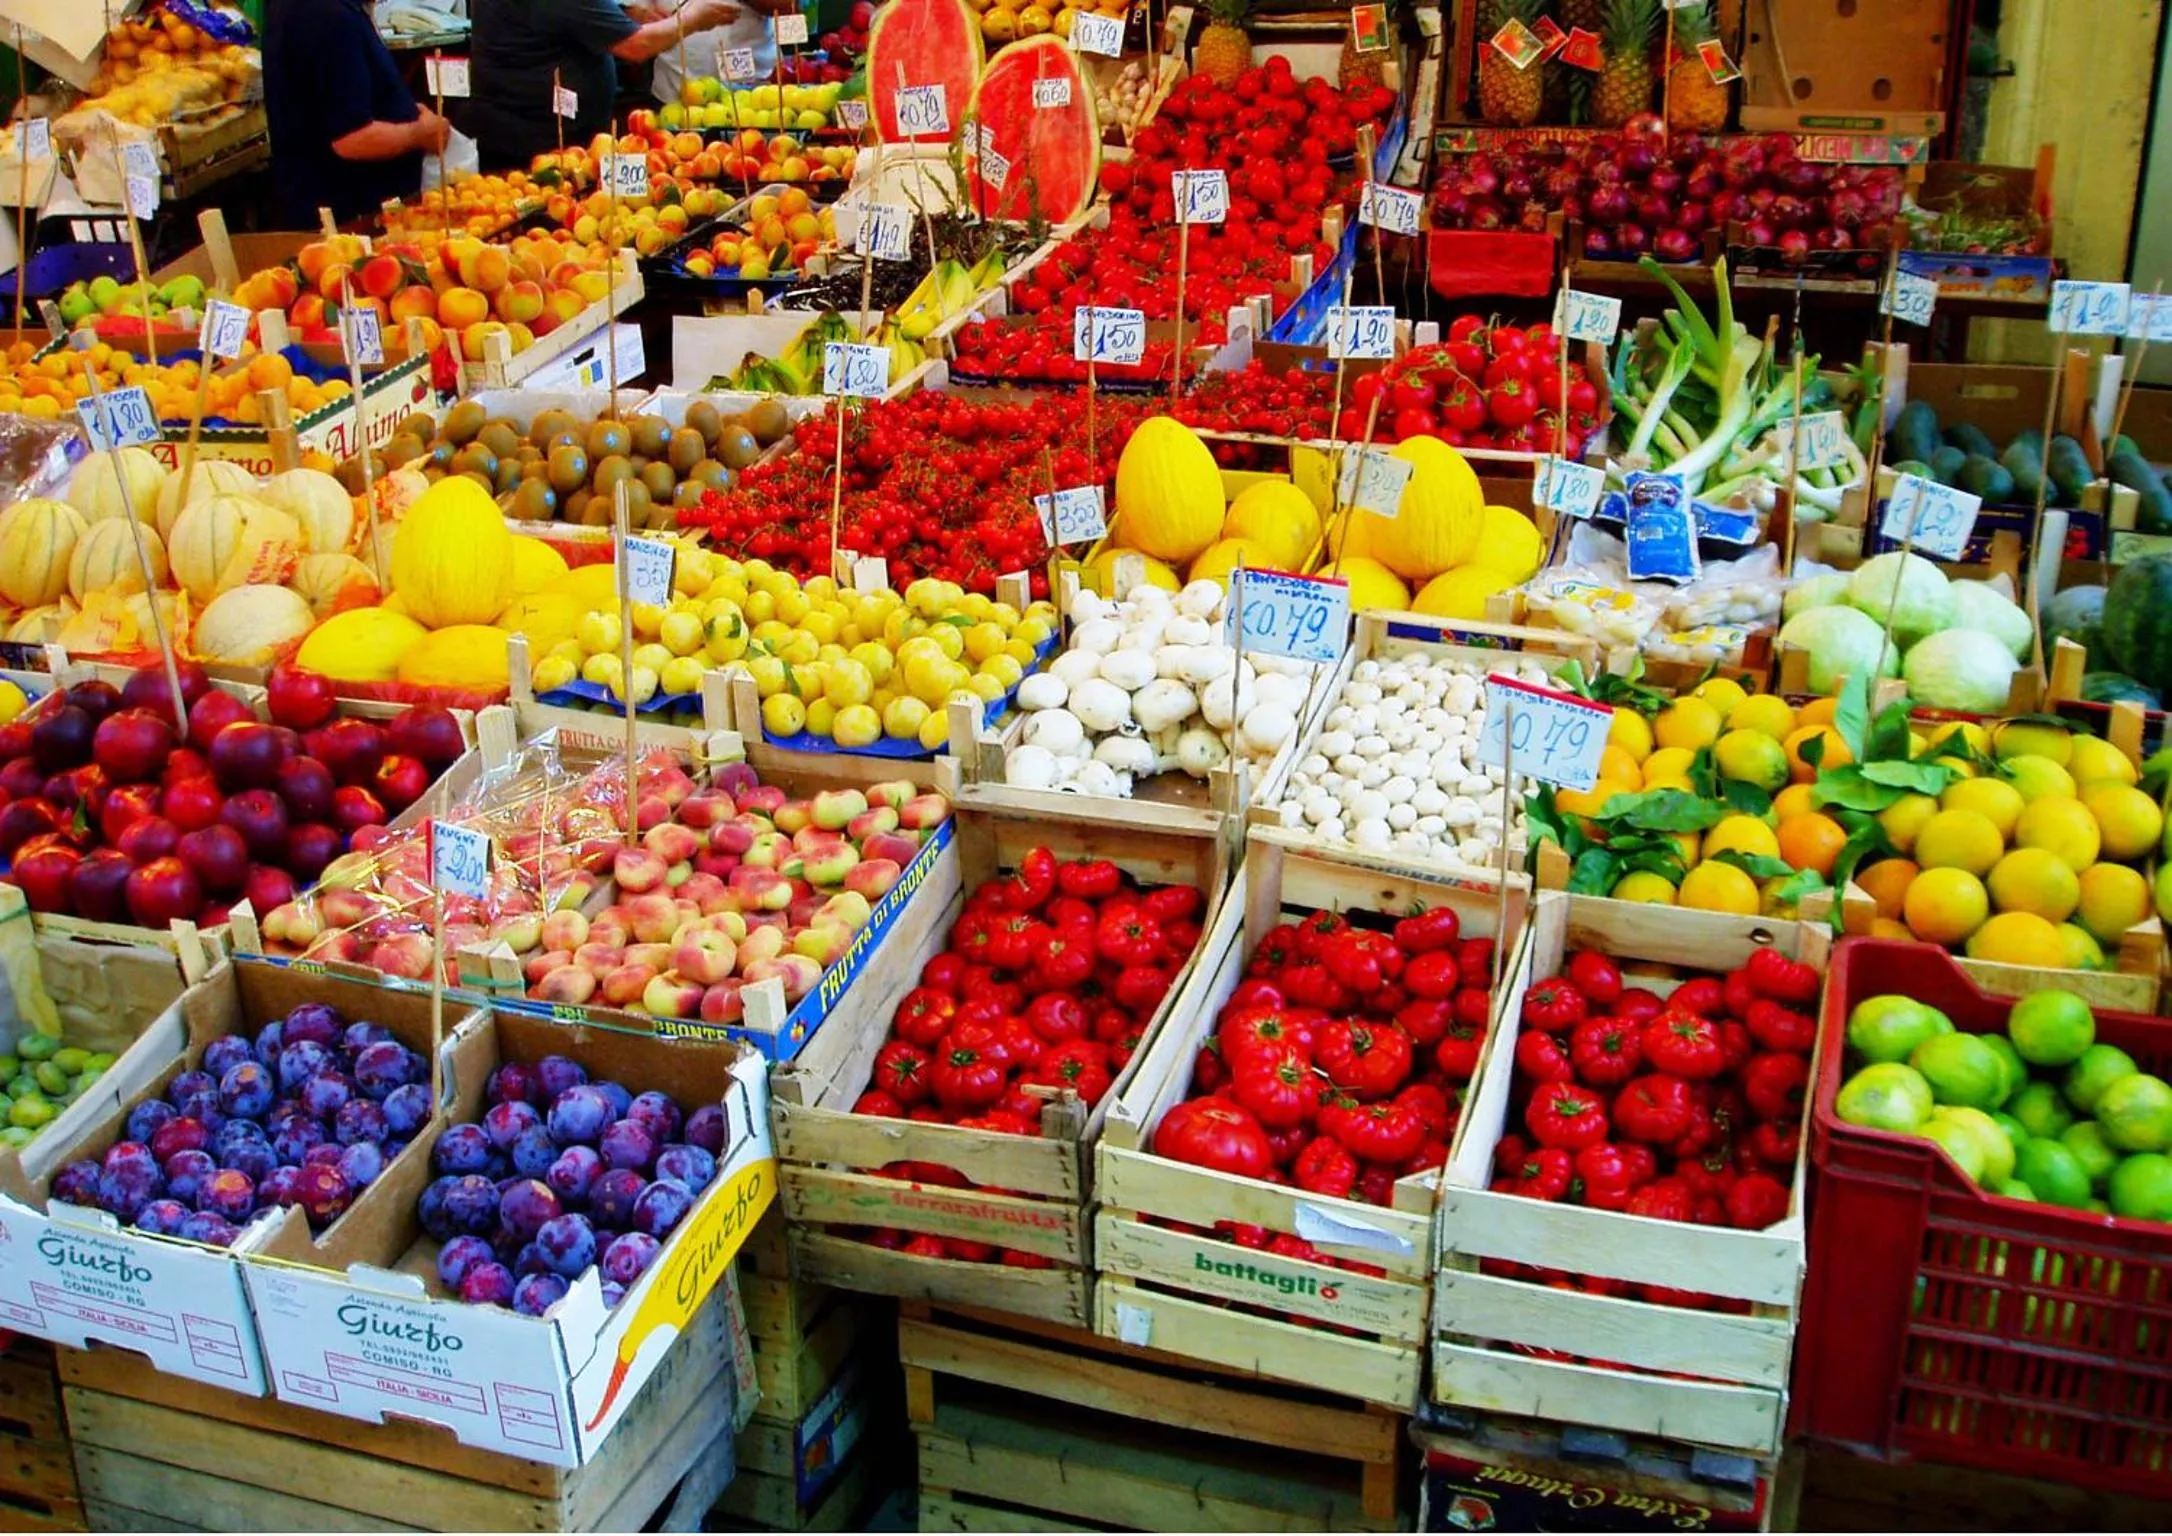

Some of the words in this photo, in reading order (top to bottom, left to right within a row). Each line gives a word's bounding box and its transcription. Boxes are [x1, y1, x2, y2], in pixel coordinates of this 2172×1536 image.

[819, 927, 873, 1014] FRUTTA
[873, 903, 888, 929] DI
[890, 839, 940, 910] BRONTE
[362, 1349, 420, 1372] COMISO
[431, 1365, 455, 1379] RG
[376, 1378, 409, 1396] ITALIA
[416, 1387, 454, 1405] SICILIA
